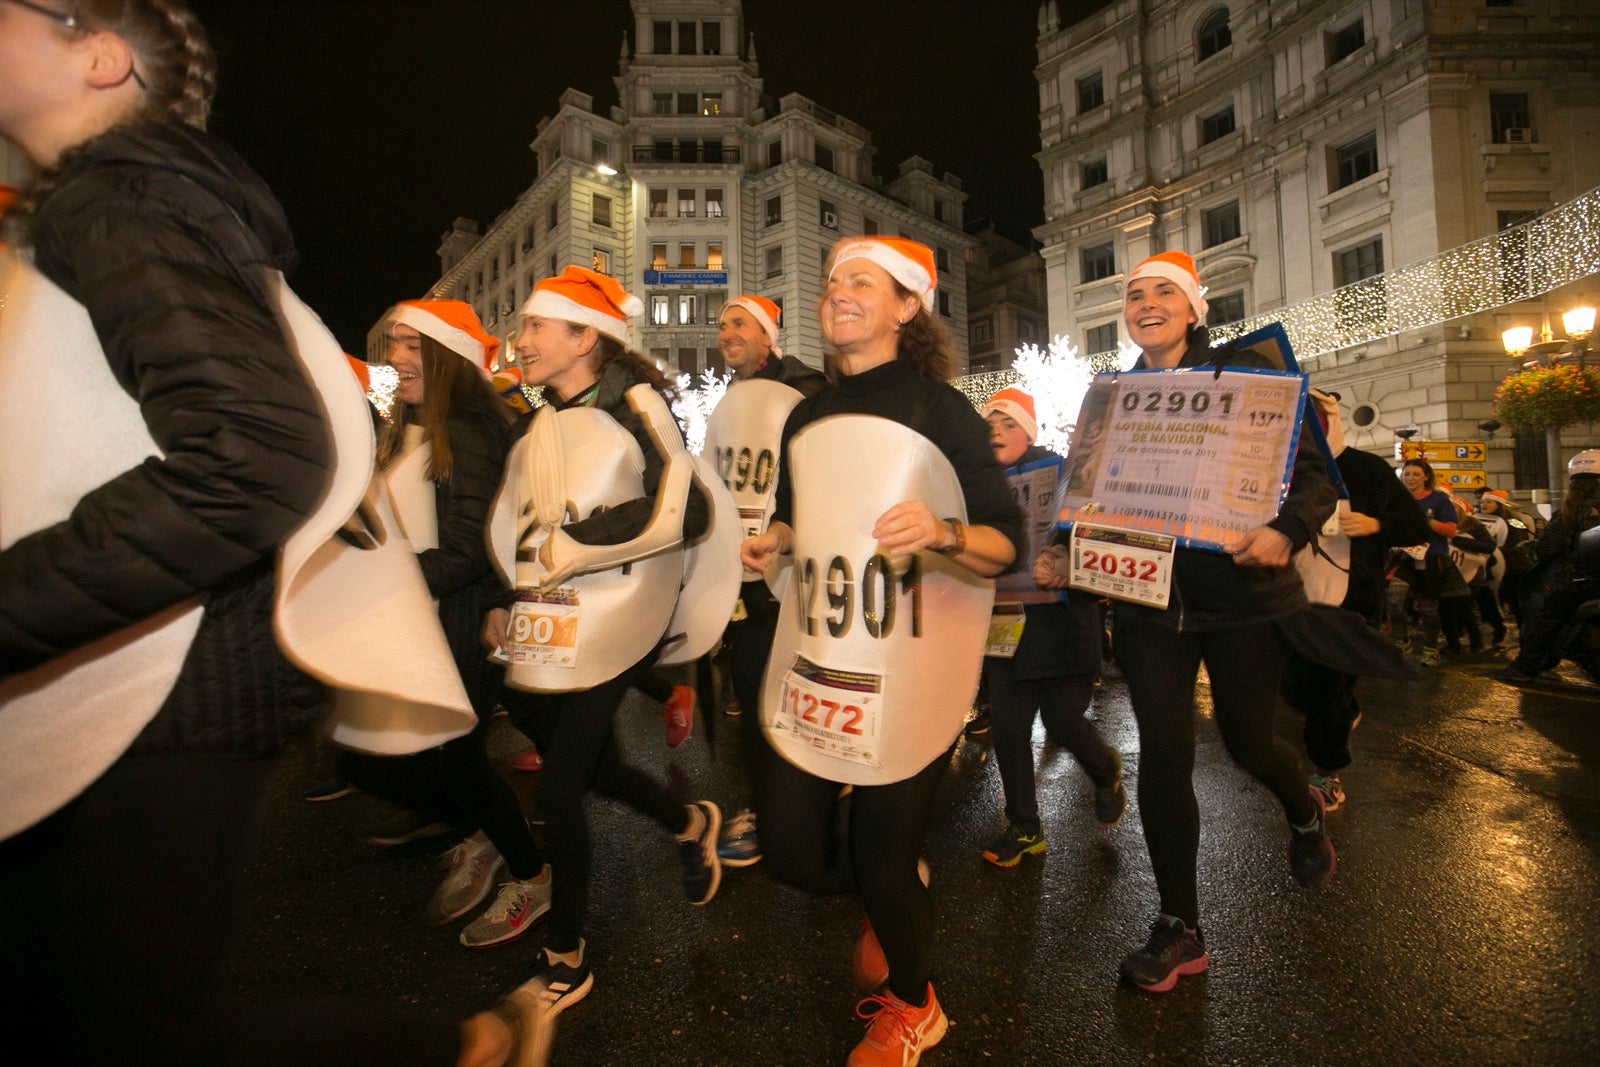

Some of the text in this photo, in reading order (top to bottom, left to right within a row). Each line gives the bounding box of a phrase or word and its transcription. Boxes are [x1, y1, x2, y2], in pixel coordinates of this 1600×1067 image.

[1122, 391, 1234, 414] 02901
[1166, 422, 1229, 435] NACIONAL
[1132, 433, 1205, 445] DE NAVIDAD
[1128, 445, 1138, 453] de
[1140, 446, 1179, 455] diciembre
[1183, 447, 1194, 456] de
[1240, 478, 1259, 494] 20
[1083, 549, 1158, 583] 2032
[789, 687, 864, 736] 1272
